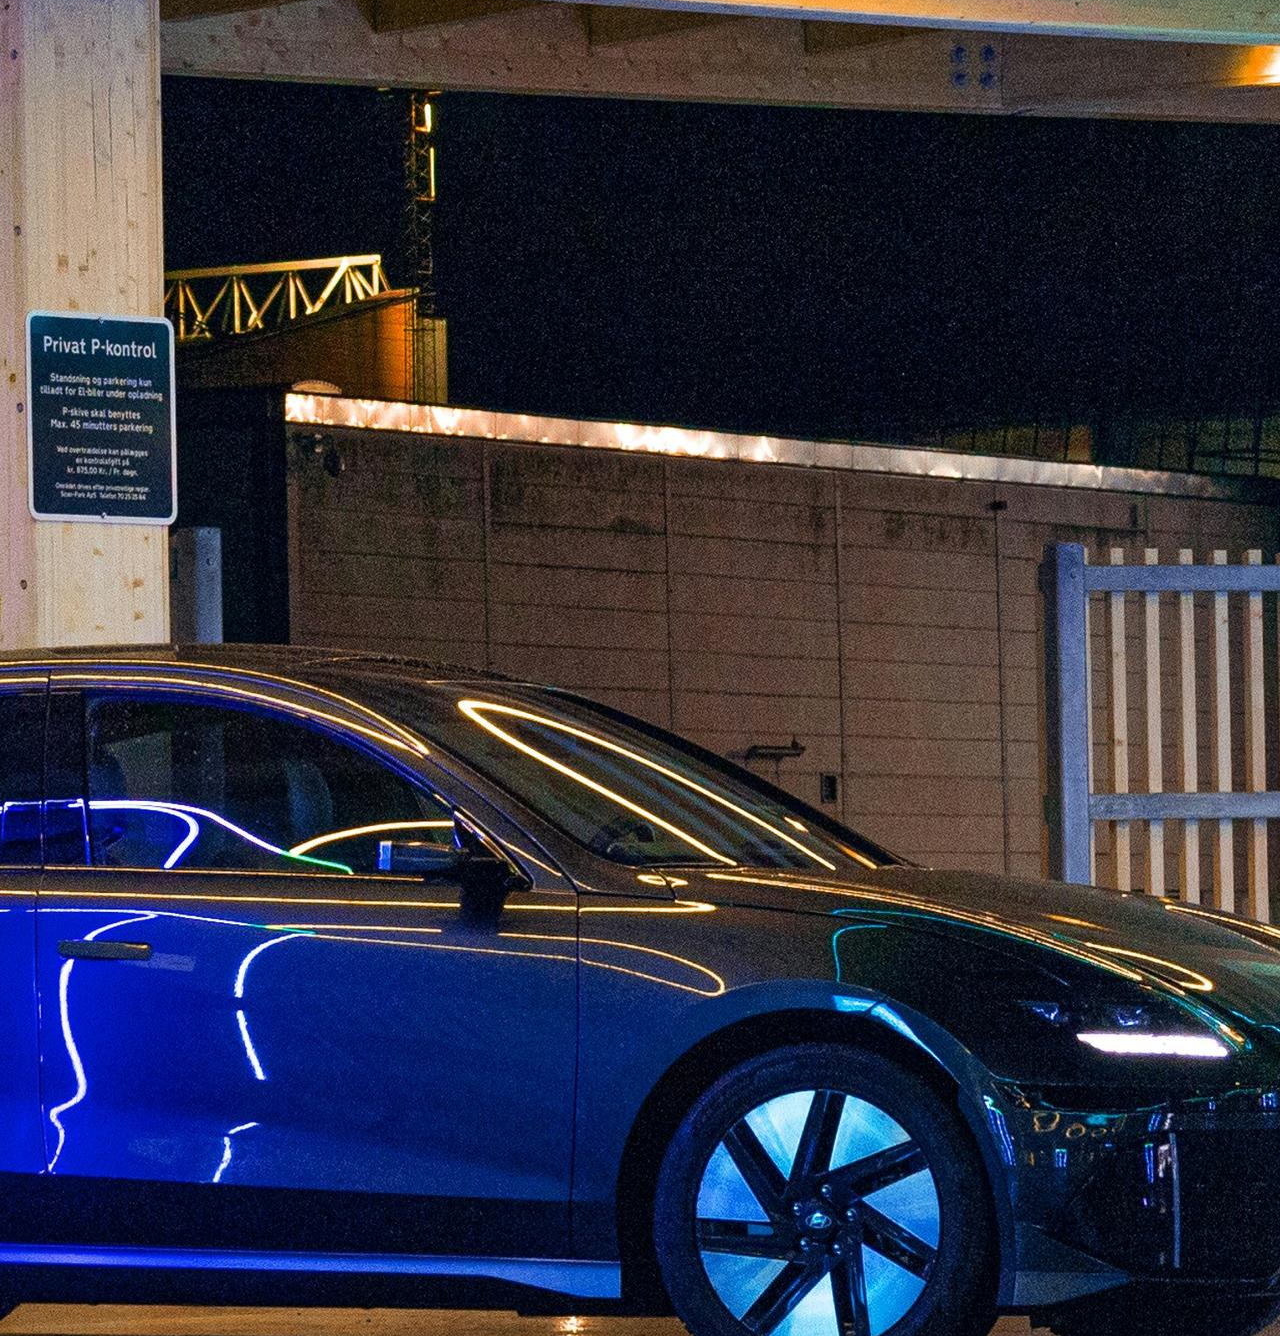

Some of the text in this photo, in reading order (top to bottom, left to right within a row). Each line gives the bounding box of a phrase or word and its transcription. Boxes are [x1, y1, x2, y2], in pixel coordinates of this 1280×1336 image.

[43, 335, 158, 359] Privat P-kontrol
[50, 372, 152, 388] Standsning og parkering kun
[40, 385, 163, 401] tilladt for El-biler under opladning
[62, 407, 141, 421] P-skive skal benyttes
[50, 419, 153, 434] Max. 45 minutters parkering
